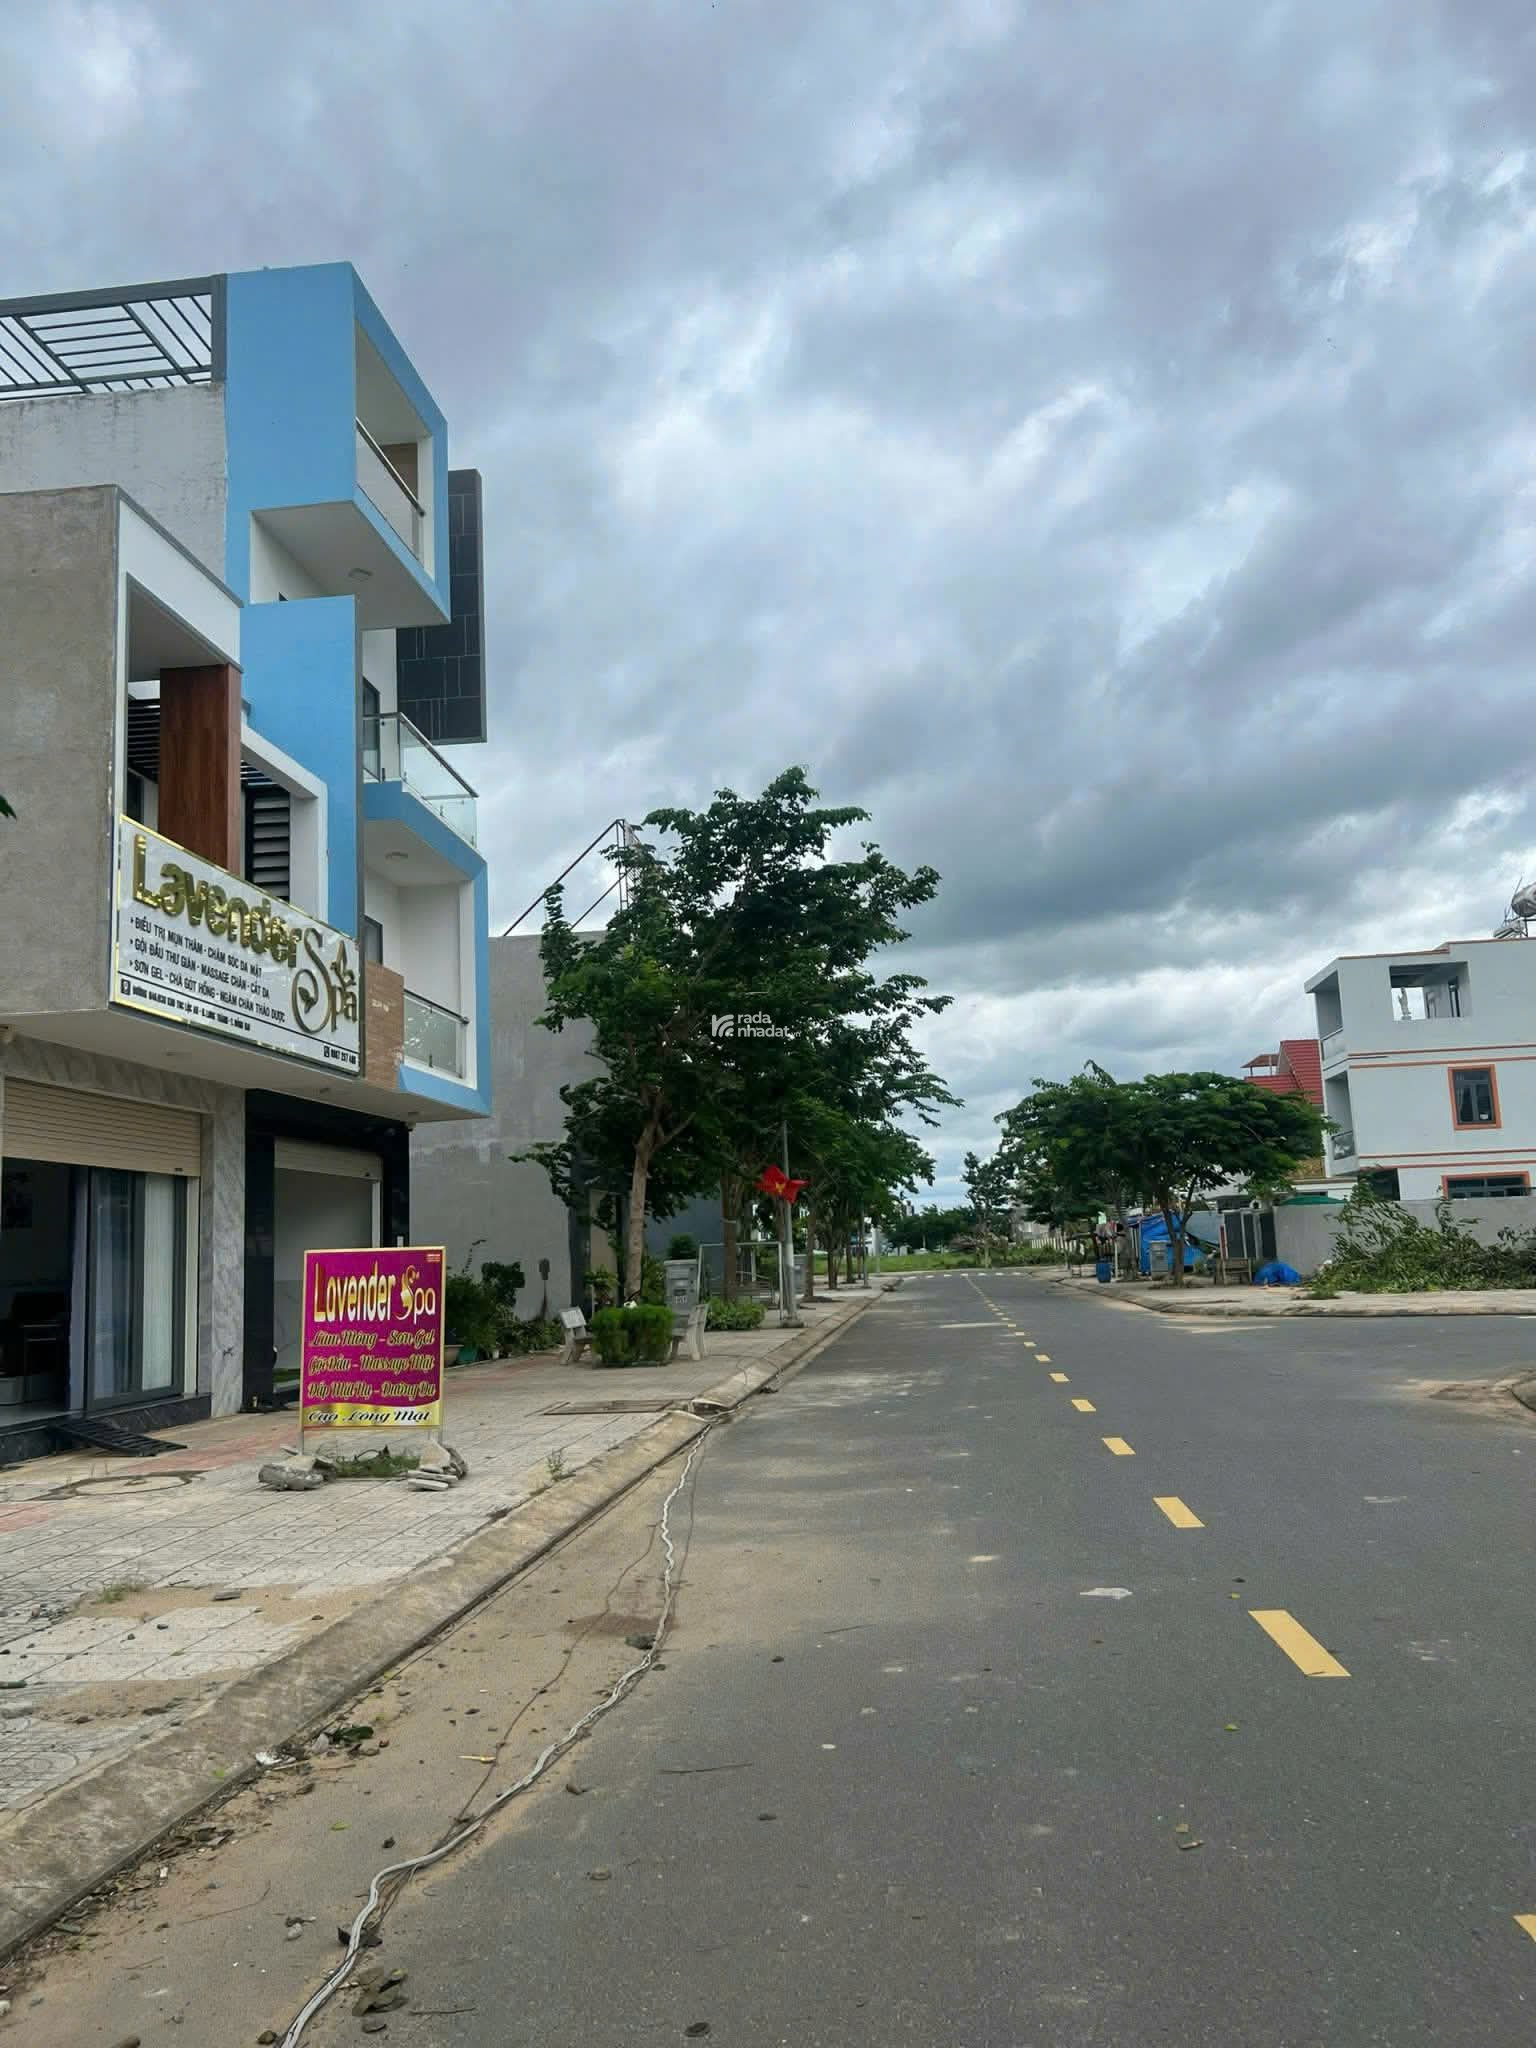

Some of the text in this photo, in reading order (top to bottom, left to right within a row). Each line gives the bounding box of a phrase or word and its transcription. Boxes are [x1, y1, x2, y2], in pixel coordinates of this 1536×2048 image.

[133, 833, 358, 1034] Lavender Spa
[151, 965, 164, 981] GEL
[201, 963, 230, 984] MASSAGE
[314, 1260, 436, 1325] Lavender Spa
